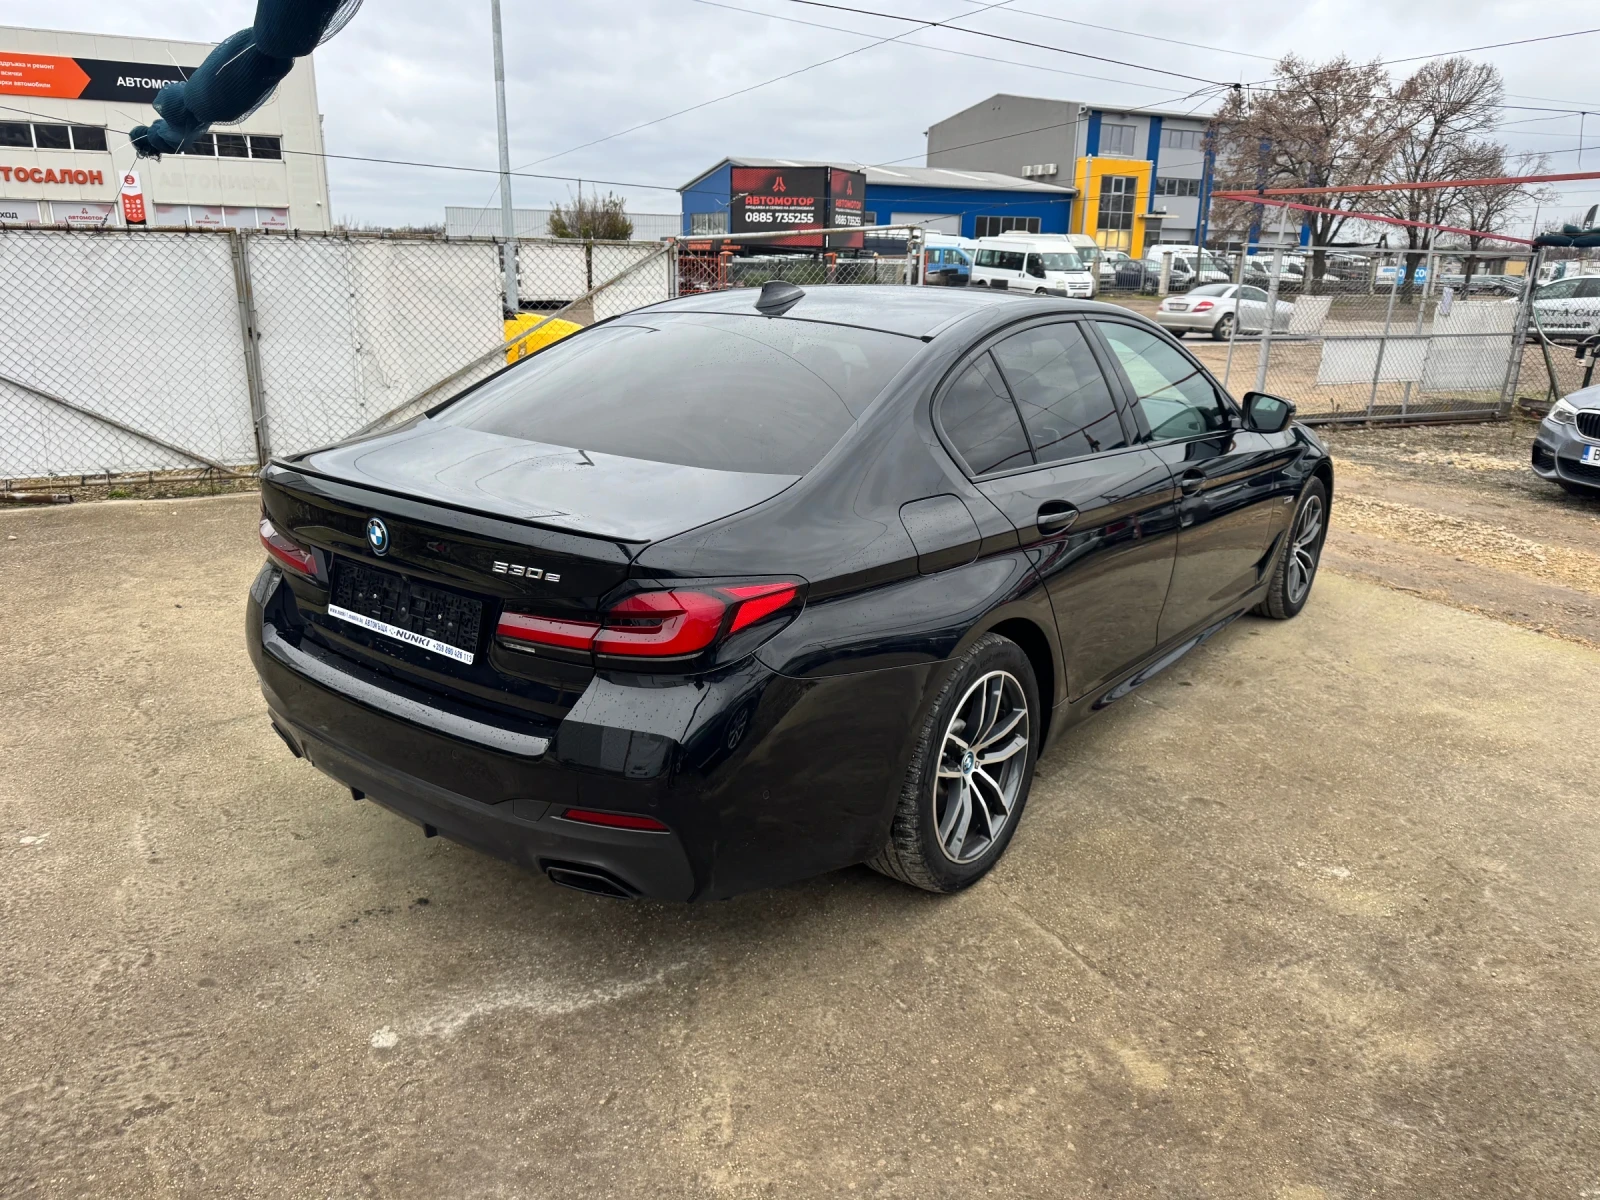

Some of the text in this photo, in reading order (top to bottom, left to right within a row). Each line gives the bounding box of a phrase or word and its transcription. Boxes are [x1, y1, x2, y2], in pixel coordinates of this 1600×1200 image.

[745, 196, 815, 206] АВТОМОТОР
[745, 211, 814, 224] 0885 735255
[492, 560, 561, 583] 530e
[395, 629, 431, 647] NUNKI
